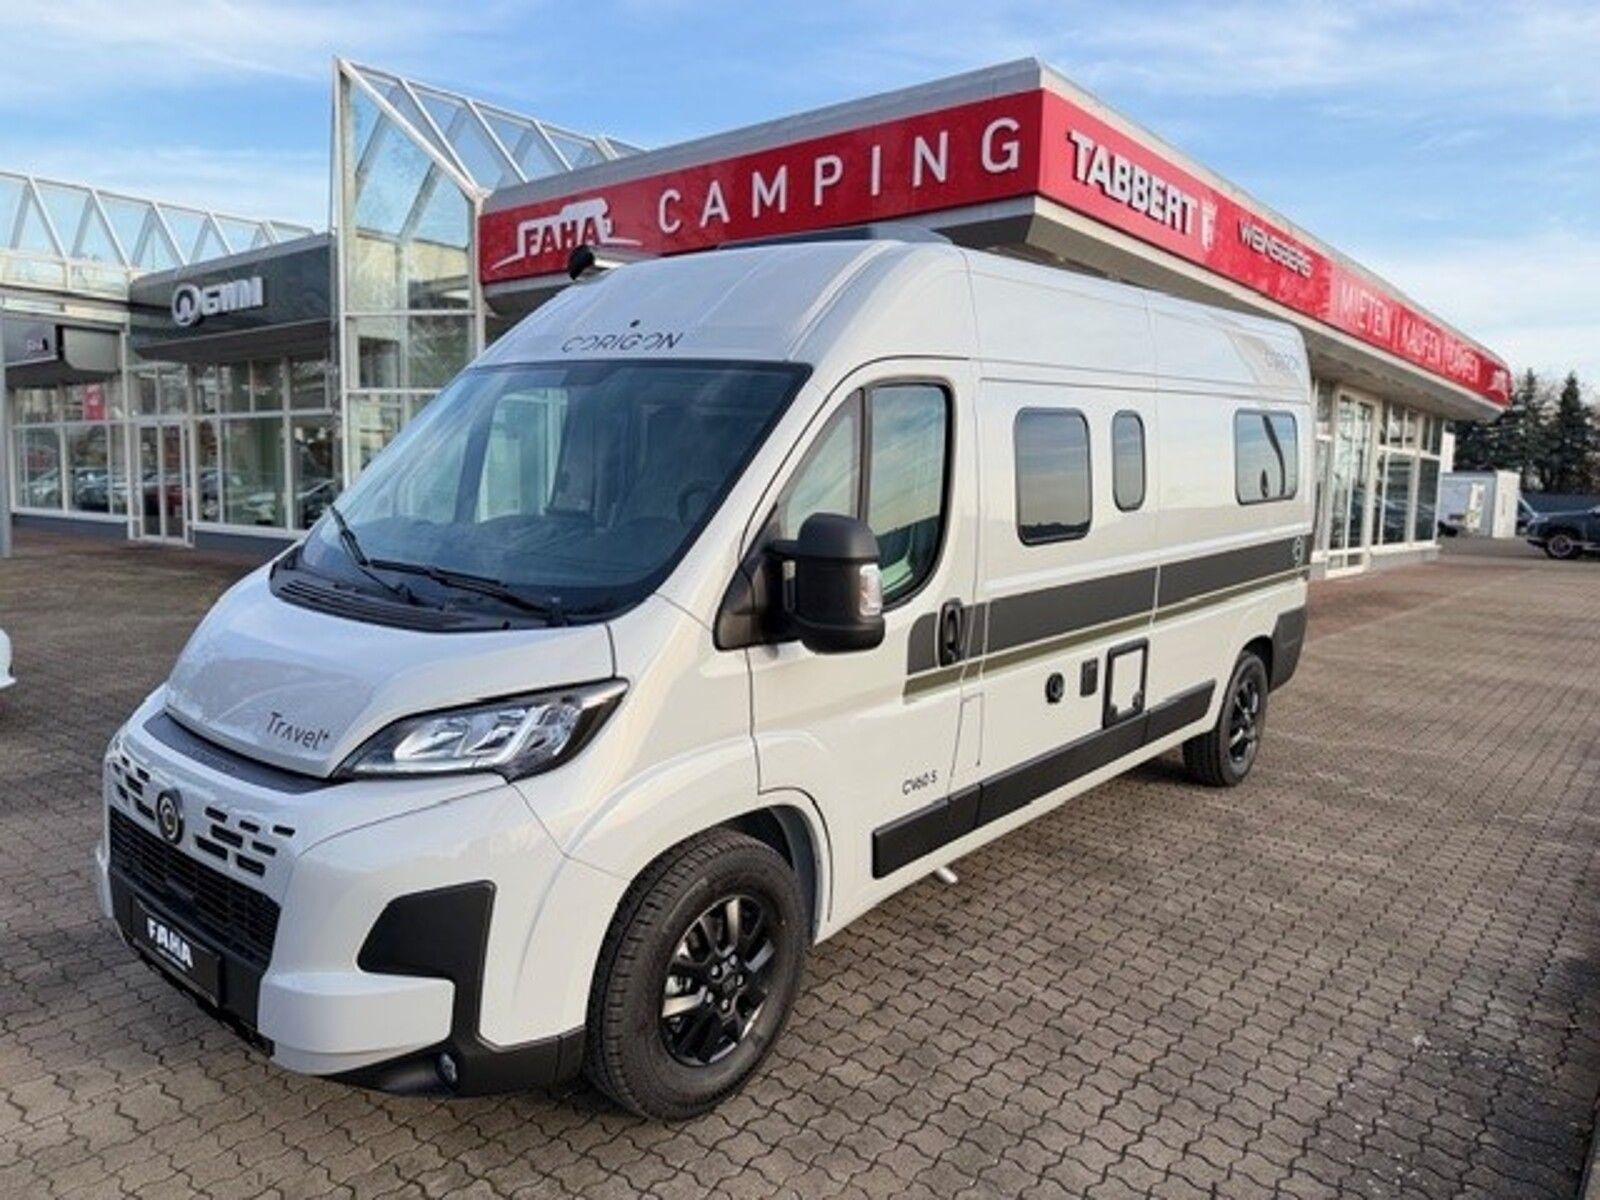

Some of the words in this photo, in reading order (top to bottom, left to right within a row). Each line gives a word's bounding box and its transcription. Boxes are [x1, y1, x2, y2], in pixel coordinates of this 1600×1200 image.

[659, 118, 1020, 233] CAMPING
[1069, 130, 1197, 235] TABBERT
[523, 215, 602, 258] FAHA
[561, 331, 683, 353] CORIGON
[1340, 280, 1392, 346] MIETEN
[146, 917, 194, 968] FAHA
